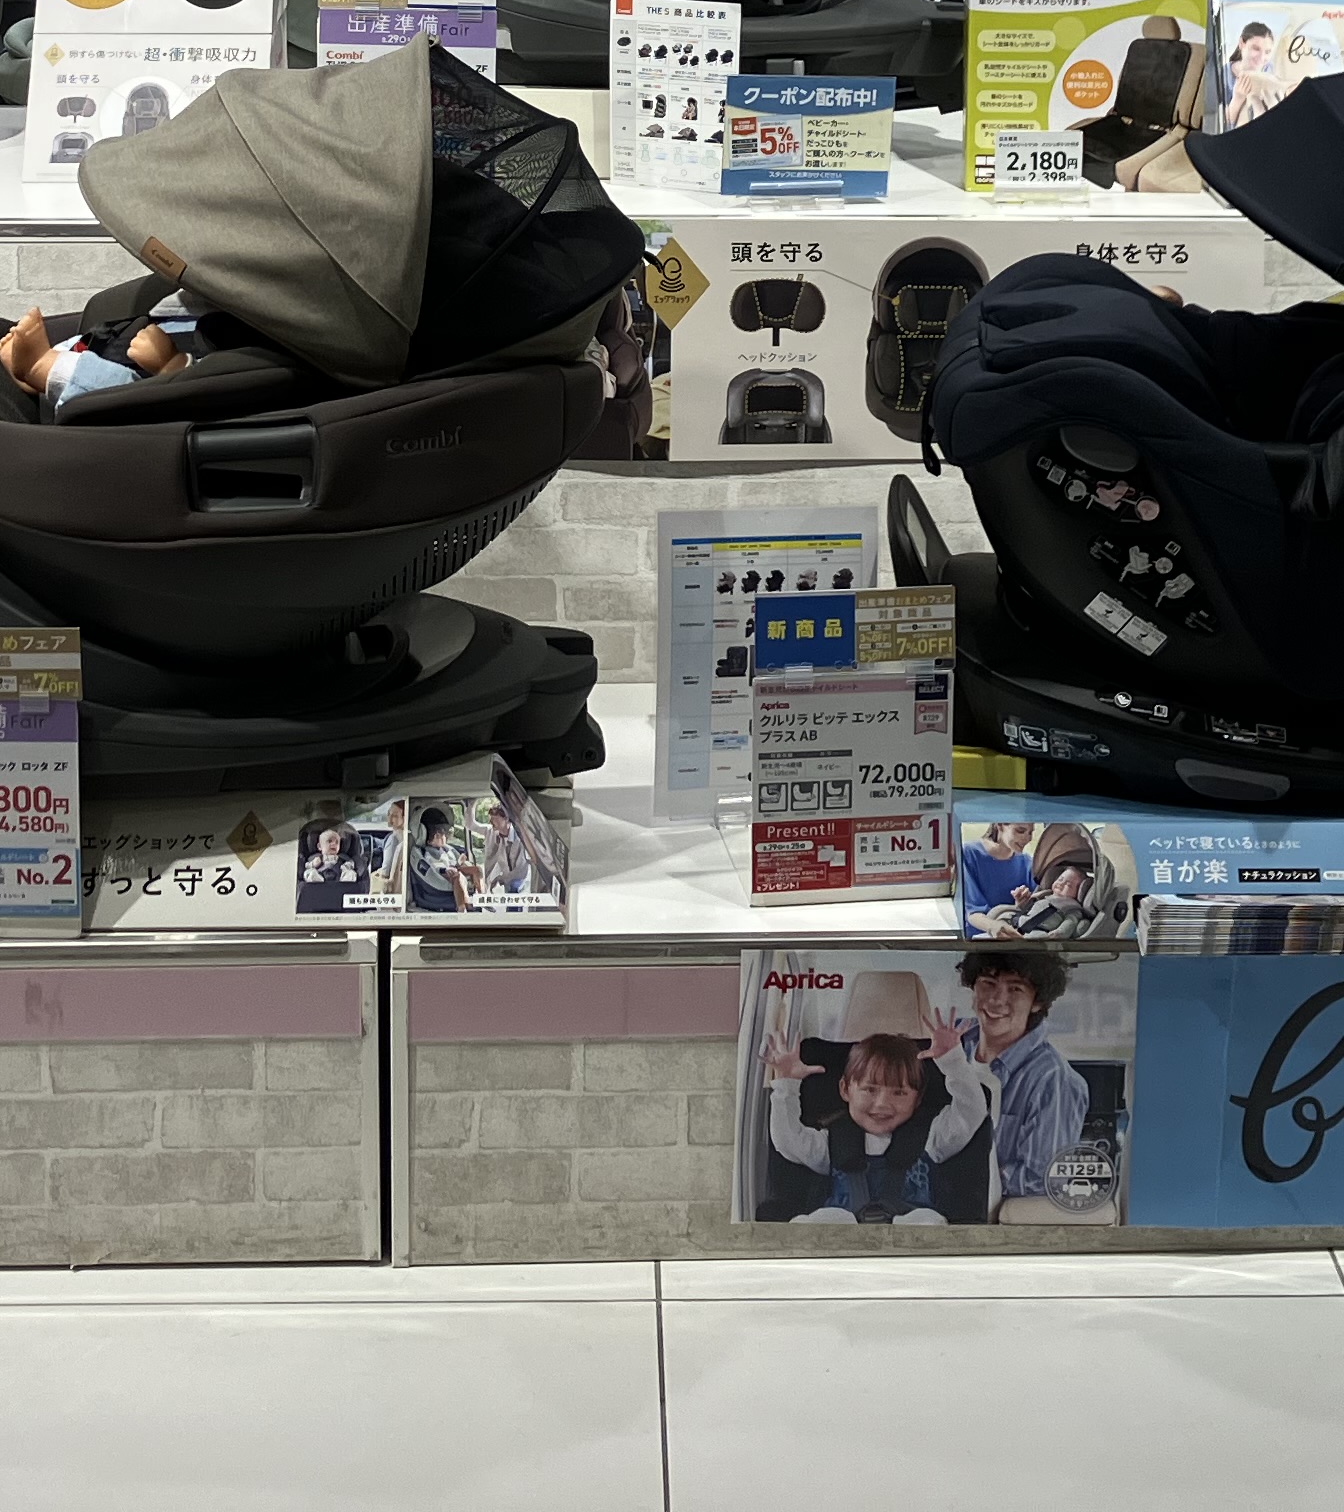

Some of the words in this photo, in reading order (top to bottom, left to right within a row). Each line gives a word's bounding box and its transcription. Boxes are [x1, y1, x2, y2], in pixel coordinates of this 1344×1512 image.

[646, 6, 663, 16] THE
[673, 7, 727, 21] 商品比較表
[347, 12, 439, 34] 出産準備
[440, 23, 471, 37] Fair
[326, 50, 365, 60] Combi
[743, 86, 877, 108] クーポン配布中!
[759, 126, 794, 156] 5%
[778, 142, 800, 154] OFF
[1006, 151, 1078, 173] 2,180円
[730, 241, 823, 264] 頭を守る
[738, 351, 818, 363] ヘッドクッション
[766, 618, 843, 640] 新商品
[896, 636, 953, 657] 7%OFF!
[760, 700, 791, 711] Aprica
[9, 713, 47, 729] Fair
[759, 713, 808, 728] クルリラ
[851, 709, 900, 724] エックス
[759, 729, 796, 744] プラス
[799, 729, 818, 743] AB
[21, 761, 48, 772] ロック
[858, 762, 946, 786] 72,000円
[766, 822, 836, 840] Present!!
[890, 818, 940, 853] No.1
[82, 833, 214, 851] エッグショックで
[15, 852, 73, 887] No.2
[1149, 857, 1227, 886] 首が楽
[1239, 869, 1317, 882] ナチュラクッション
[81, 865, 259, 898] ずっと守る。
[762, 967, 844, 992] Aprica
[1056, 1162, 1096, 1177] R129
